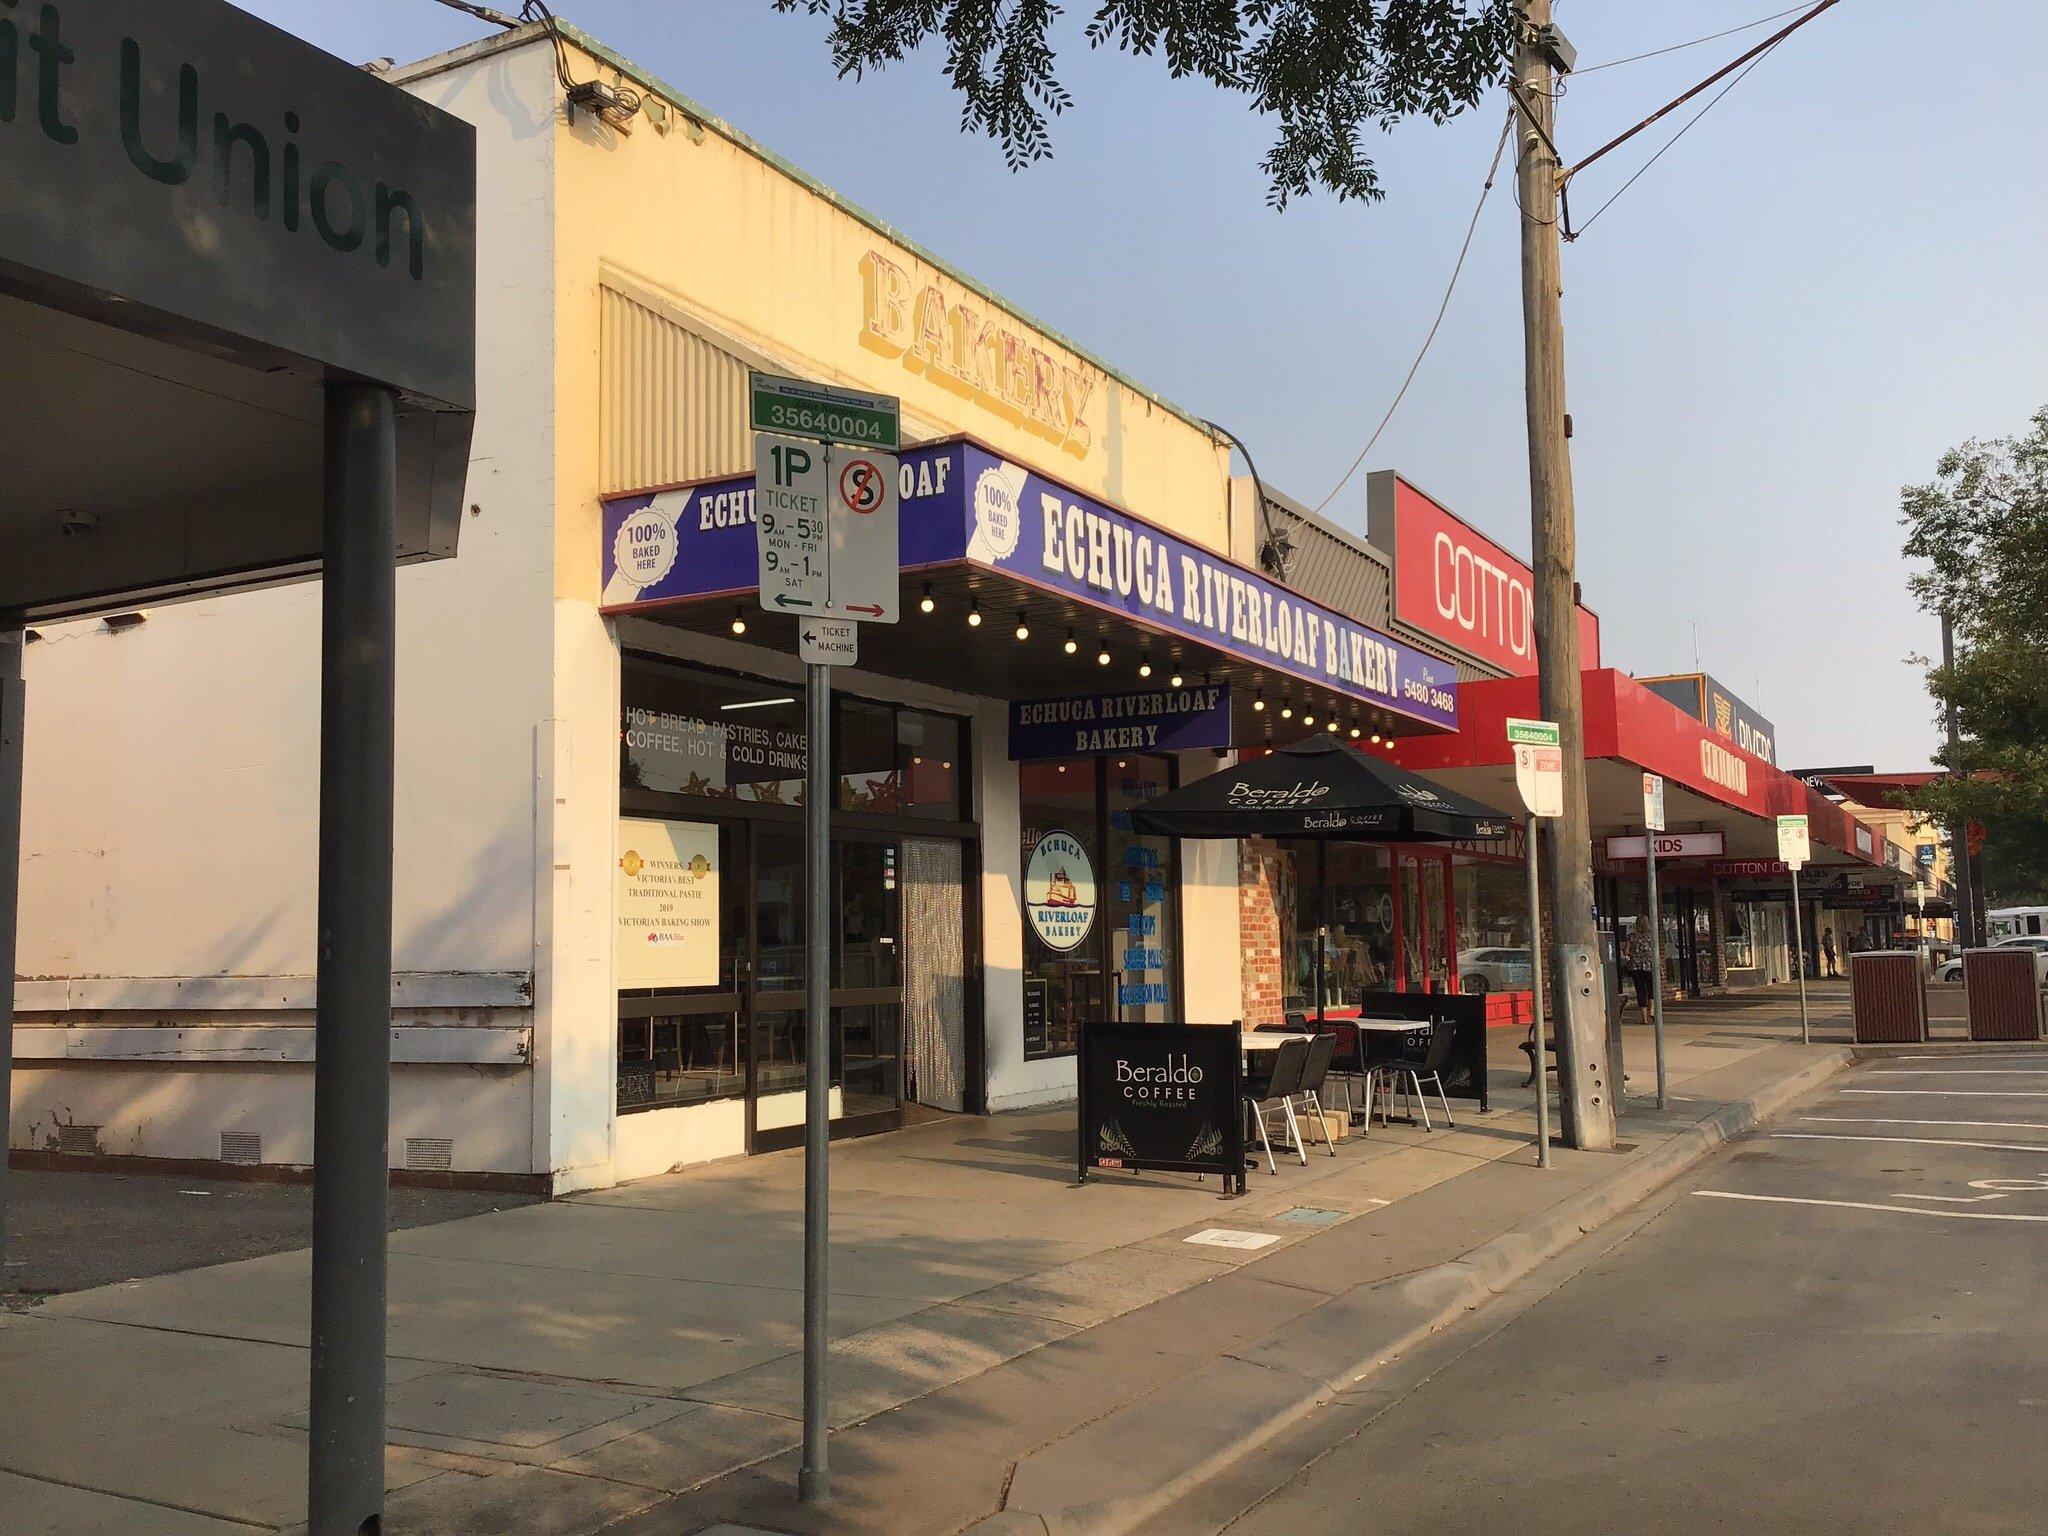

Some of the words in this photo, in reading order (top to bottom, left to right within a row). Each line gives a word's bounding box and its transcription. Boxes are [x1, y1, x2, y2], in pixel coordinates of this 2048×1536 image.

[119, 37, 424, 281] Union
[859, 249, 1095, 458] BAKERY
[771, 405, 882, 439] 35640004
[770, 445, 811, 487] 1P
[766, 489, 818, 514] TICKET
[983, 484, 1011, 512] 100%
[988, 509, 1008, 528] BAKED
[627, 526, 666, 545] 100%
[991, 527, 1005, 541] HERE
[632, 544, 660, 559] BAKED
[769, 538, 790, 549] MON
[801, 542, 817, 553] FRI
[636, 557, 656, 571] HERE
[785, 577, 803, 588] SAT
[1041, 492, 1174, 613] ECHUCA
[1181, 555, 1319, 668] RIVERLOAF
[1324, 619, 1398, 698] BAKERY
[822, 626, 850, 638] TICKET
[818, 641, 855, 653] MACHINE
[1404, 679, 1428, 704] 5480
[1431, 688, 1454, 713] 3468
[1020, 698, 1095, 725] ECHUCA
[1101, 688, 1220, 718] RIVERLOAF
[626, 707, 656, 727] HOT
[1076, 725, 1158, 751] BAKERY
[688, 738, 715, 758] HOT
[719, 744, 727, 760] &
[732, 746, 764, 764] COLD
[1228, 781, 1330, 798] Beraldo
[1304, 811, 1347, 829] Beraldo
[1040, 839, 1080, 860] ECHUCA
[650, 860, 683, 869] WINNERS
[1713, 862, 1768, 875] COTTON
[678, 876, 694, 884] BEST
[629, 889, 677, 898] TRADITIONAL
[679, 890, 703, 898] PASTIE
[659, 904, 674, 912] 2019
[1037, 910, 1088, 923] RIVERLOAF
[618, 917, 659, 926] VICTORIAN
[661, 918, 689, 926] BAKING
[690, 918, 711, 926] SHOW
[1045, 926, 1081, 937] BAKERY
[1116, 1053, 1203, 1084] Beraldo
[1124, 1086, 1196, 1100] COFFEE
[1132, 1099, 1157, 1108] Freshly
[1159, 1100, 1187, 1108] Roasted
